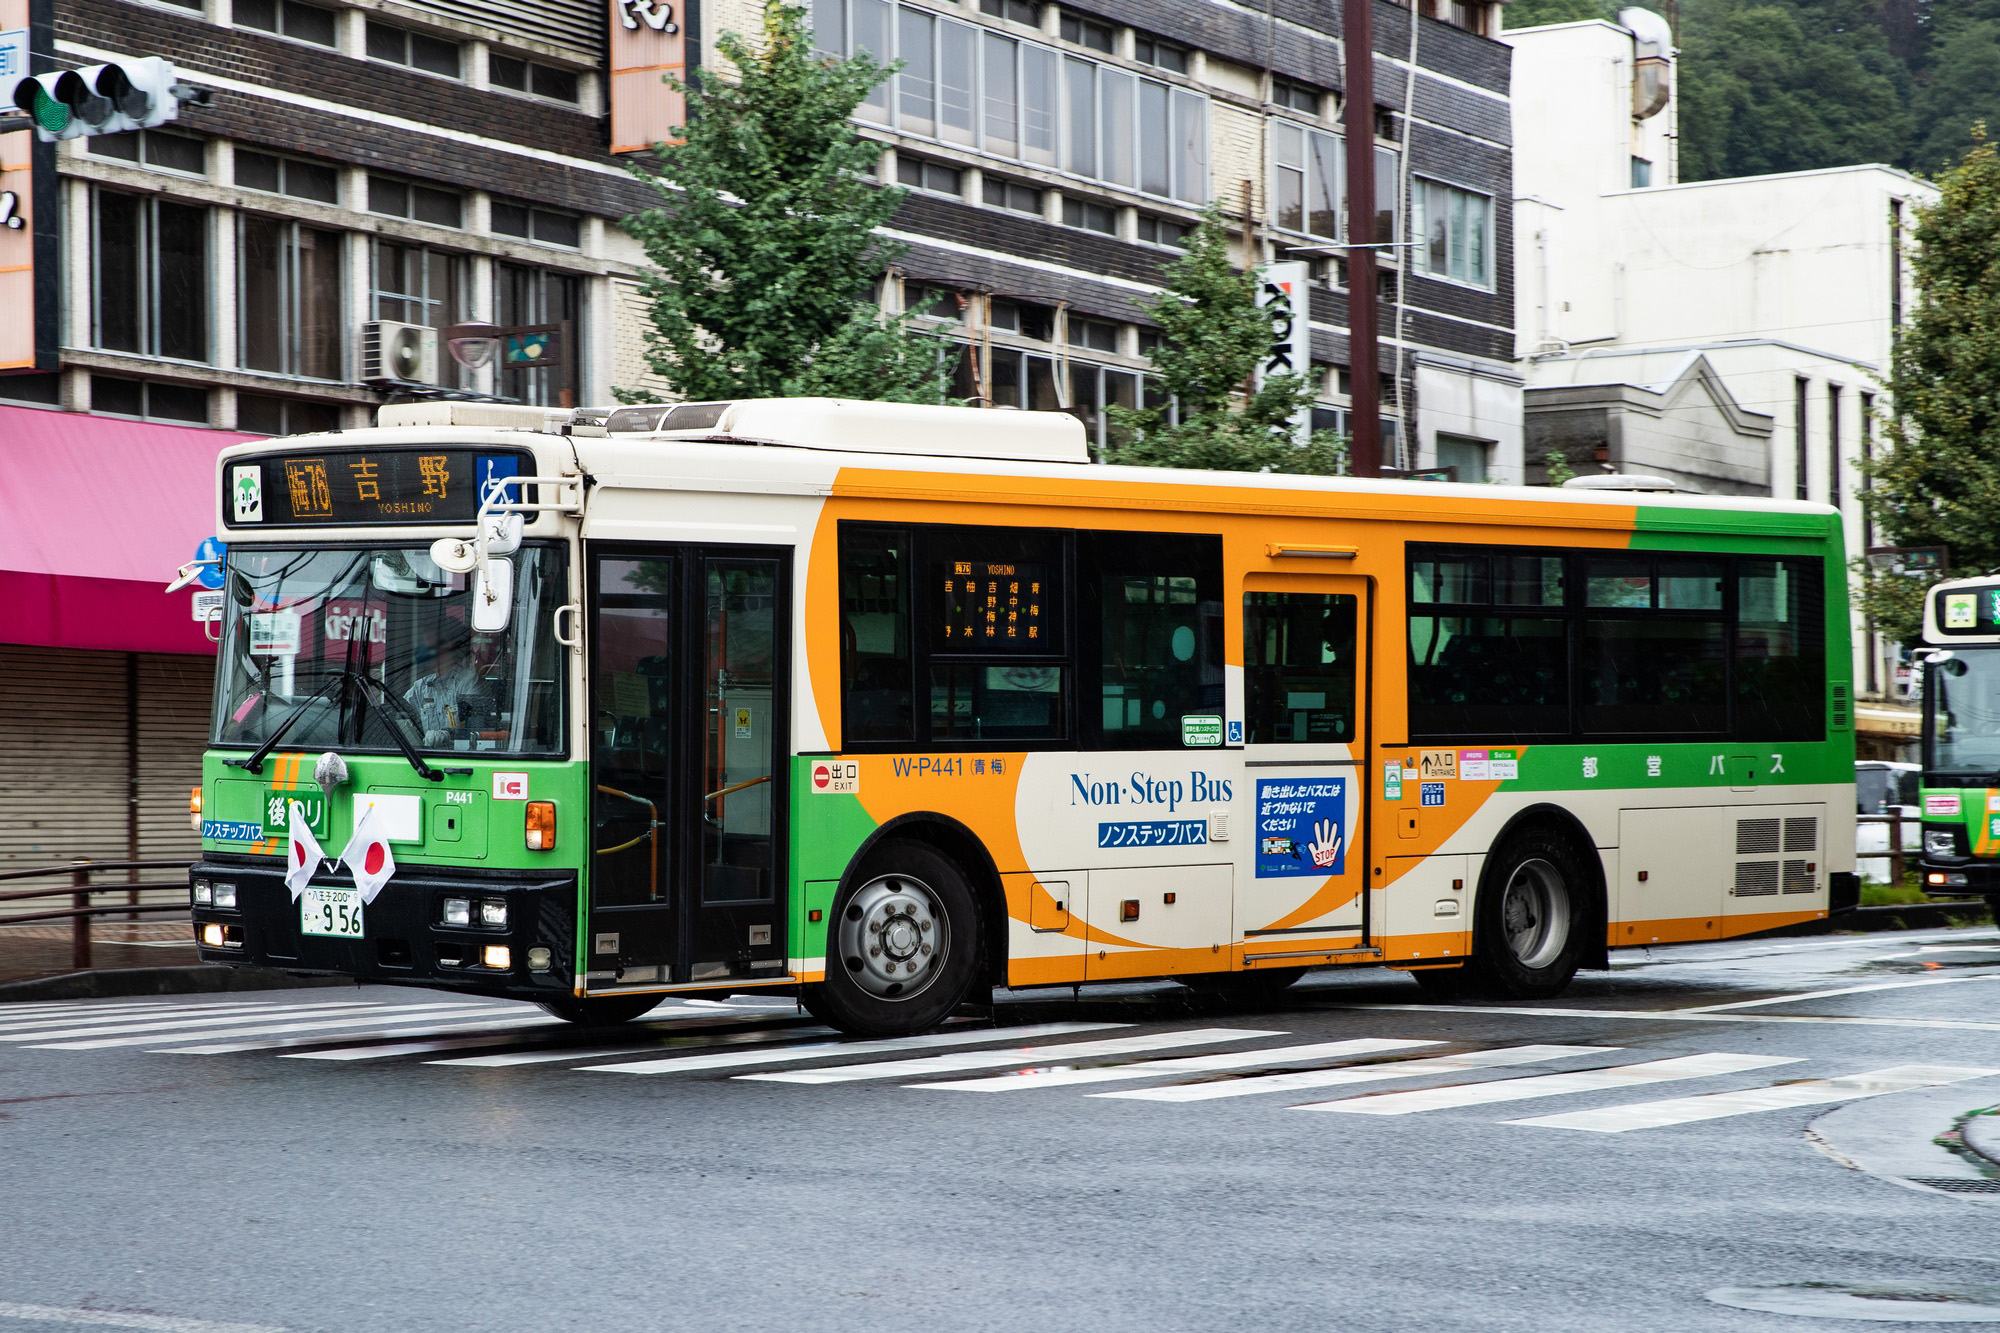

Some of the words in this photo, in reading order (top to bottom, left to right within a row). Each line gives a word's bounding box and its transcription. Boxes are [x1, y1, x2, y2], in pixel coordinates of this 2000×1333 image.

[349, 455, 450, 501] 吉野
[378, 503, 432, 514] YOSHINO
[987, 564, 1015, 576] YOSHINO
[1028, 582, 1040, 638] 青梅駅
[893, 757, 963, 777] W-P441
[1434, 753, 1453, 766] 入口
[1582, 753, 1785, 778] 都営バス
[832, 764, 856, 779] 出口
[1431, 768, 1456, 777] ENTRANCE
[834, 782, 853, 790] EXIT
[1190, 770, 1233, 803] Bus
[1261, 784, 1341, 799] 動き出したバスには
[446, 791, 472, 804] P441
[1261, 802, 1316, 816] 近づかないで
[203, 822, 264, 840] ノンステップバス
[1261, 818, 1297, 832] ください
[1099, 822, 1206, 846] ノンステップバス
[1315, 848, 1335, 863] STOP
